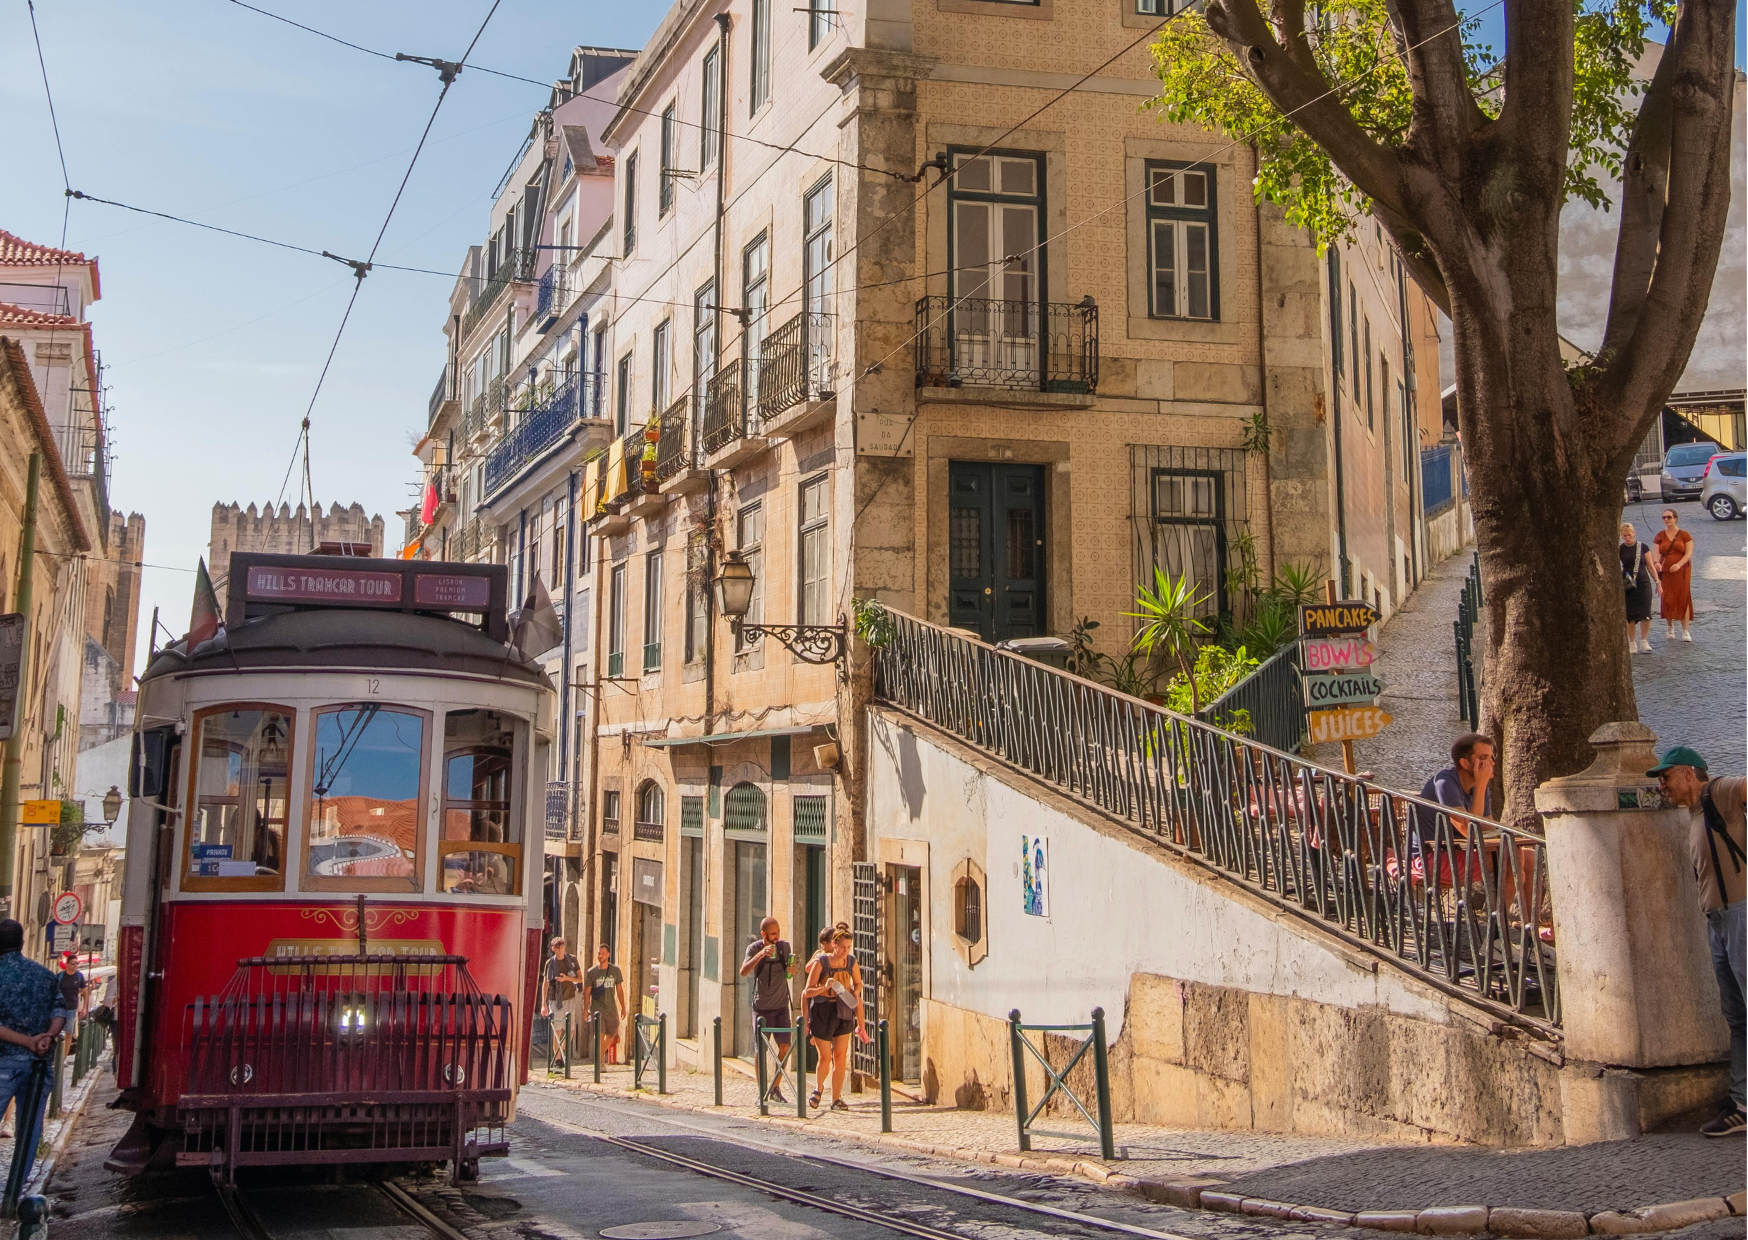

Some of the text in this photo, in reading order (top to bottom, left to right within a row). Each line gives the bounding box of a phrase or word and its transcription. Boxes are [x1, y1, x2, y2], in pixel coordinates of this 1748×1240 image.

[257, 574, 392, 596] HILLS TRAMCAR TOUR
[1305, 607, 1376, 630] PANCAKES
[1308, 641, 1374, 668] BOWLS
[366, 678, 380, 694] 12
[206, 848, 229, 856] PRIVATE
